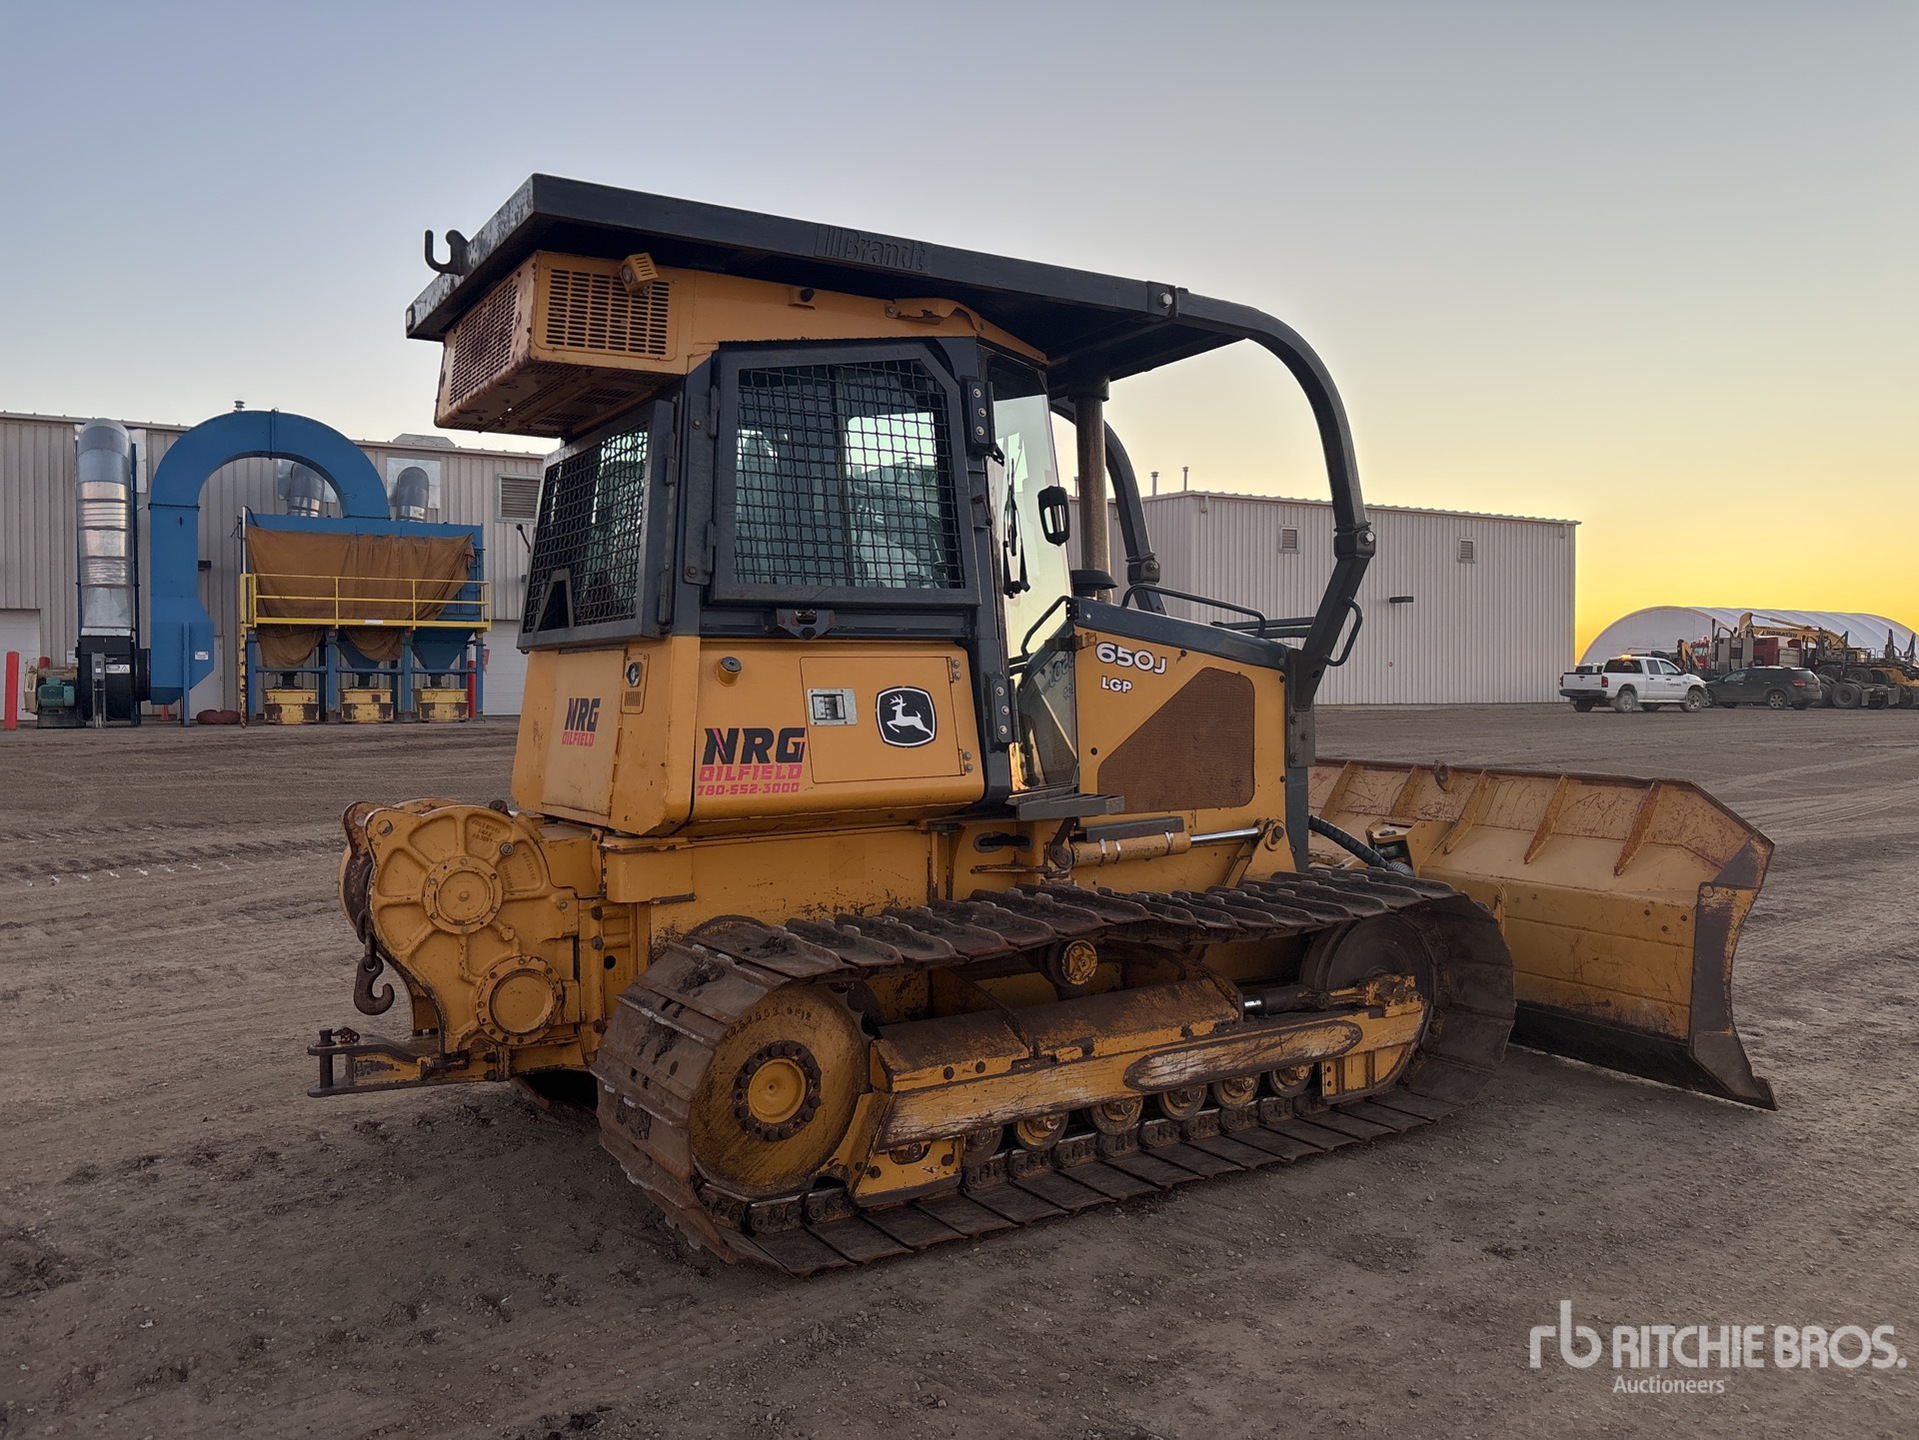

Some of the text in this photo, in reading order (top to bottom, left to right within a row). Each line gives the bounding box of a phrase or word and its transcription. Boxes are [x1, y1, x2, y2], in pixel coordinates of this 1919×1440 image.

[844, 228, 927, 271] Brandt
[1766, 630, 1798, 638] KOMATSU
[1095, 642, 1167, 674] 650J
[1101, 675, 1133, 693] LGP
[564, 698, 601, 732] NRG
[562, 731, 595, 748] OILFIELD
[702, 728, 806, 765] NRG
[699, 764, 803, 782] OILFIELD
[697, 782, 800, 796] 780-552-3000
